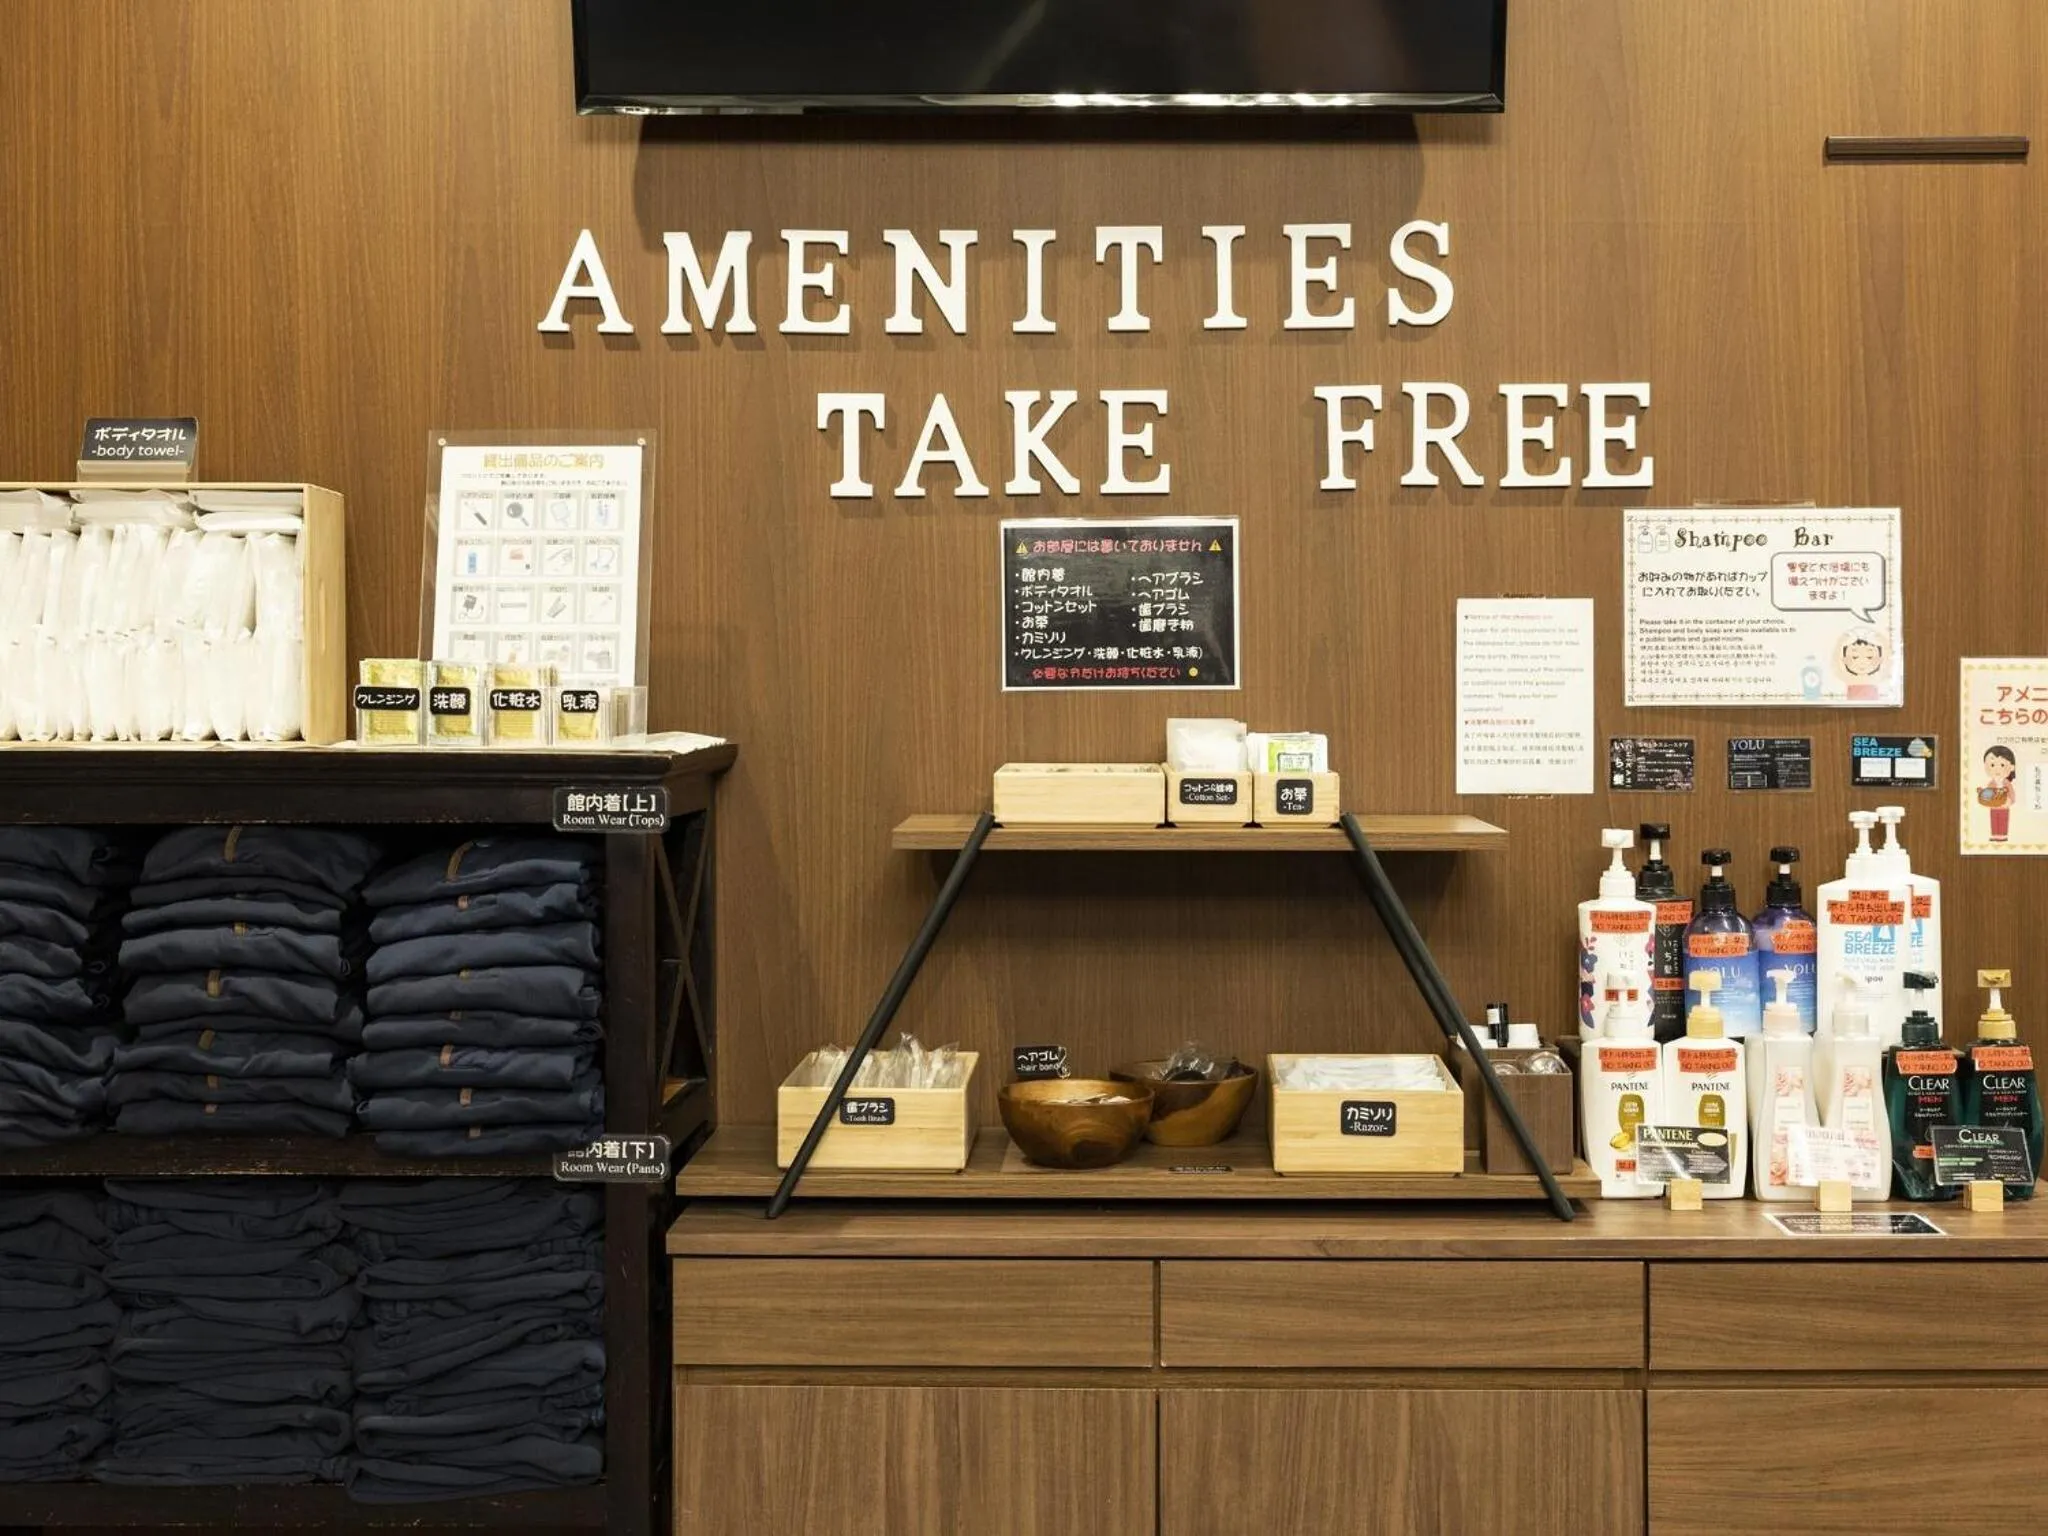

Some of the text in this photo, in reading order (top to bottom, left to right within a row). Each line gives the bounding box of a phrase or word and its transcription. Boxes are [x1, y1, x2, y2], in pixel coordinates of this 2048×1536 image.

[537, 220, 1454, 334] AMENITIES
[94, 426, 187, 442] ボディタオル
[817, 382, 1653, 498] TAKE FREE
[1674, 526, 1833, 552] Shampoo Bar
[1032, 539, 1203, 554] お部屋には置いておりません
[357, 693, 416, 706] クレンジング
[433, 693, 467, 709] 洗顔
[492, 692, 540, 708] 化粧水
[562, 694, 597, 711] 乳液
[1979, 707, 2048, 726] こちらの
[1731, 739, 1765, 751] YOLU
[1853, 737, 1878, 747] SEA
[1853, 747, 1902, 757] BREEZE
[1280, 787, 1308, 802] お茶
[563, 813, 595, 825] Room
[1844, 931, 1873, 943] SEA
[1844, 942, 1896, 955] BREEZE
[1017, 1050, 1059, 1062] ヘアゴム
[1610, 1081, 1649, 1092] PANTENE
[1691, 1081, 1731, 1092] PANTENE
[1908, 1075, 1950, 1091] CLEAR
[1982, 1074, 2026, 1090] CLEAR
[846, 1101, 889, 1113] 歯ブラシ
[1346, 1107, 1393, 1121] カミソリ
[1349, 1122, 1389, 1133] -Razor-
[1643, 1128, 1694, 1141] PANTENE
[1958, 1128, 2000, 1143] CLEAR
[561, 1162, 593, 1173] Room
